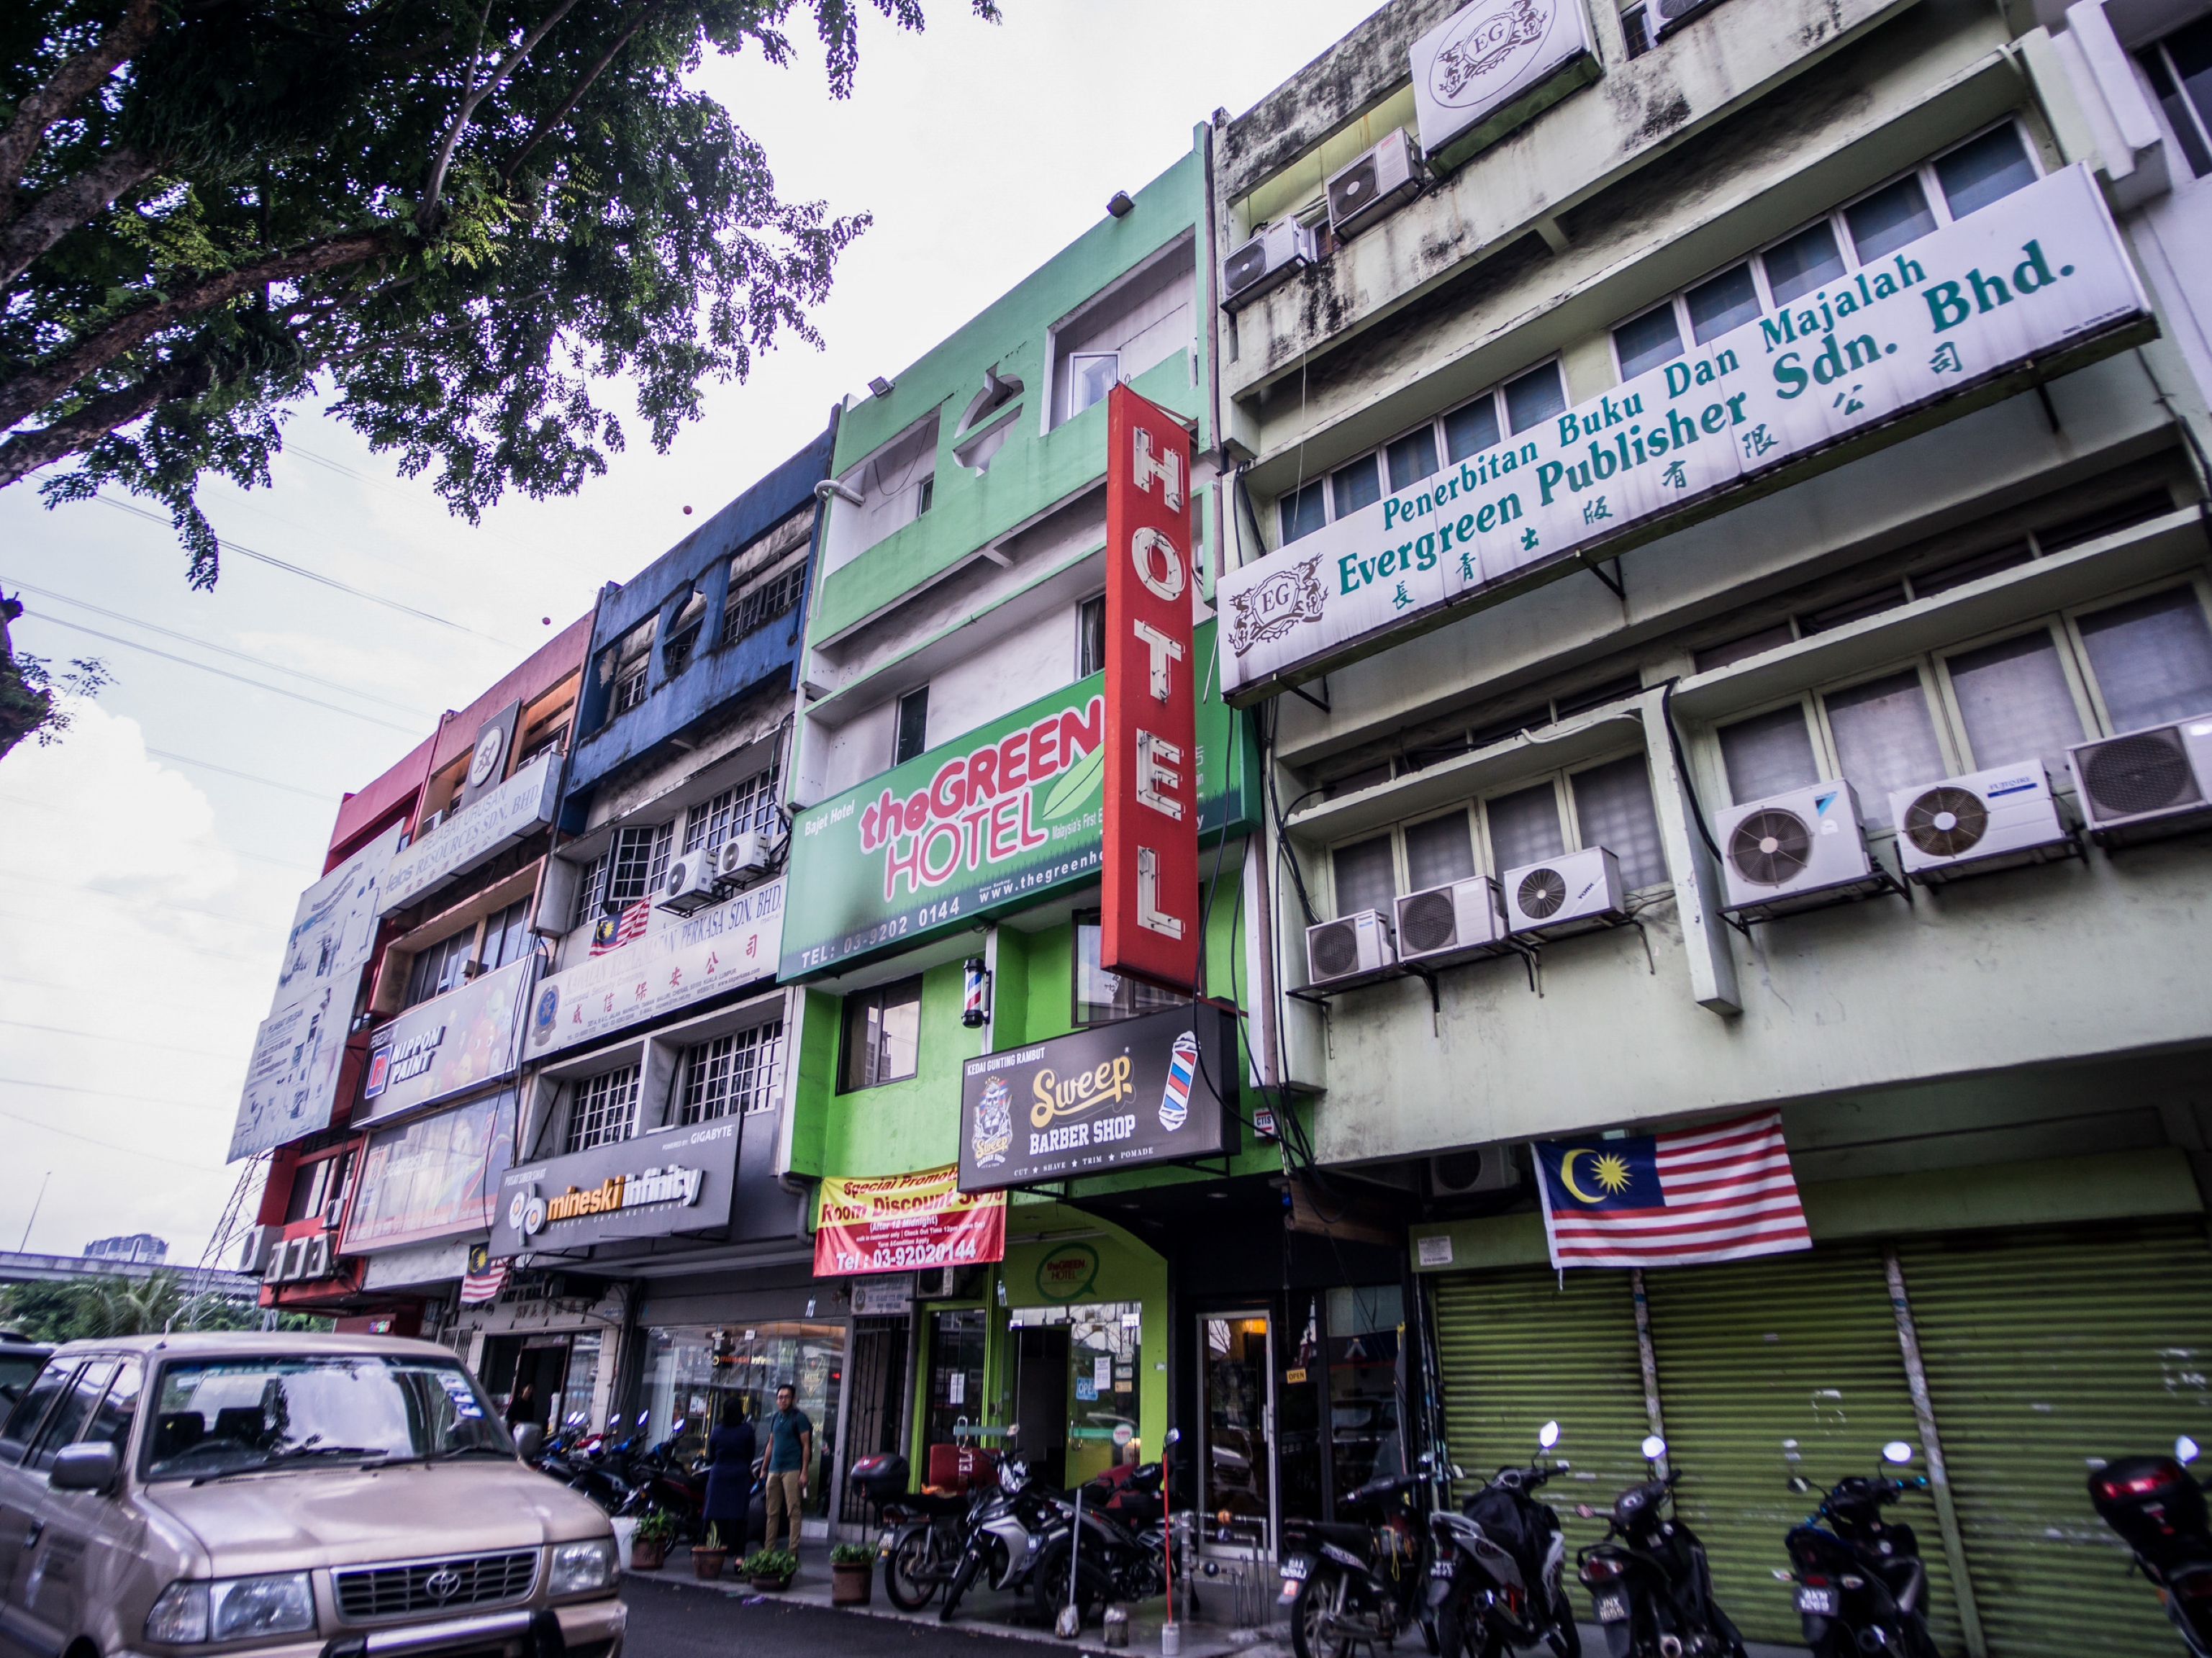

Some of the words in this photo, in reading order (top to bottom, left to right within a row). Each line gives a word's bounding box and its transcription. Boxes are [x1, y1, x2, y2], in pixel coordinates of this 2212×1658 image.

[1474, 23, 1505, 55] EG
[1382, 436, 1538, 531] Penerbitan
[1558, 393, 1644, 448] Buku
[1664, 348, 1740, 400] Dan
[1759, 253, 1928, 354] Majalah
[1336, 489, 1523, 596] Evergreen
[1536, 391, 1747, 507] Publisher
[1772, 330, 1898, 400] Sdn.
[1921, 238, 2075, 333] Bhd.
[1261, 581, 1292, 613] EG
[1132, 425, 1187, 941] HOTEL
[415, 819, 482, 876] RESOURCES
[481, 803, 508, 834] SDN.
[512, 783, 540, 816] BHD.
[421, 816, 461, 854] PEJABAT
[463, 784, 508, 825] URUSAN
[804, 812, 828, 837] Bajet
[830, 799, 856, 825] Hotel
[1052, 817, 1082, 841] Malaysia's
[1083, 812, 1097, 828] First
[884, 786, 1047, 902] HOTEL
[979, 850, 1103, 904] www.thegreenho
[682, 908, 724, 945] PERKASA
[727, 897, 753, 930] SDN.
[756, 884, 781, 920] BHD.
[801, 945, 835, 969] TEL:
[843, 920, 907, 955] 03-9202
[918, 895, 960, 926] 0144
[390, 1025, 445, 1065] NIPPON
[967, 1061, 987, 1077] KEDAI
[987, 1054, 1016, 1072] GUNTING
[1016, 1046, 1046, 1066] RAMBUT
[390, 1050, 435, 1085] PAINT
[1030, 1054, 1133, 1129] Sweep
[690, 1125, 733, 1145] GIGABYTE
[1029, 1123, 1090, 1156] BARBER
[1093, 1114, 1136, 1143] SHOP
[1256, 1115, 1272, 1126] CTIS
[976, 1136, 1008, 1159] Sweep
[1014, 1167, 1029, 1177] CUT
[1043, 1161, 1066, 1172] SHAVE
[1082, 1154, 1103, 1165] TRIM
[1120, 1147, 1154, 1160] POMADE
[546, 1174, 625, 1221] mineski
[622, 1163, 703, 1208] infinity
[843, 1177, 897, 1199] Special
[899, 1165, 958, 1189] Promoti
[821, 1202, 867, 1223] Room
[872, 1187, 953, 1218] Discount
[550, 1218, 582, 1231] CYBER
[869, 1221, 889, 1233] (After
[891, 1220, 900, 1229] 12
[901, 1215, 938, 1229] Midnight)
[836, 1251, 860, 1272] Tel
[873, 1238, 976, 1269] 03-92020144
[1051, 1268, 1077, 1280] HOTEL
[1288, 1371, 1305, 1381] OPEN
